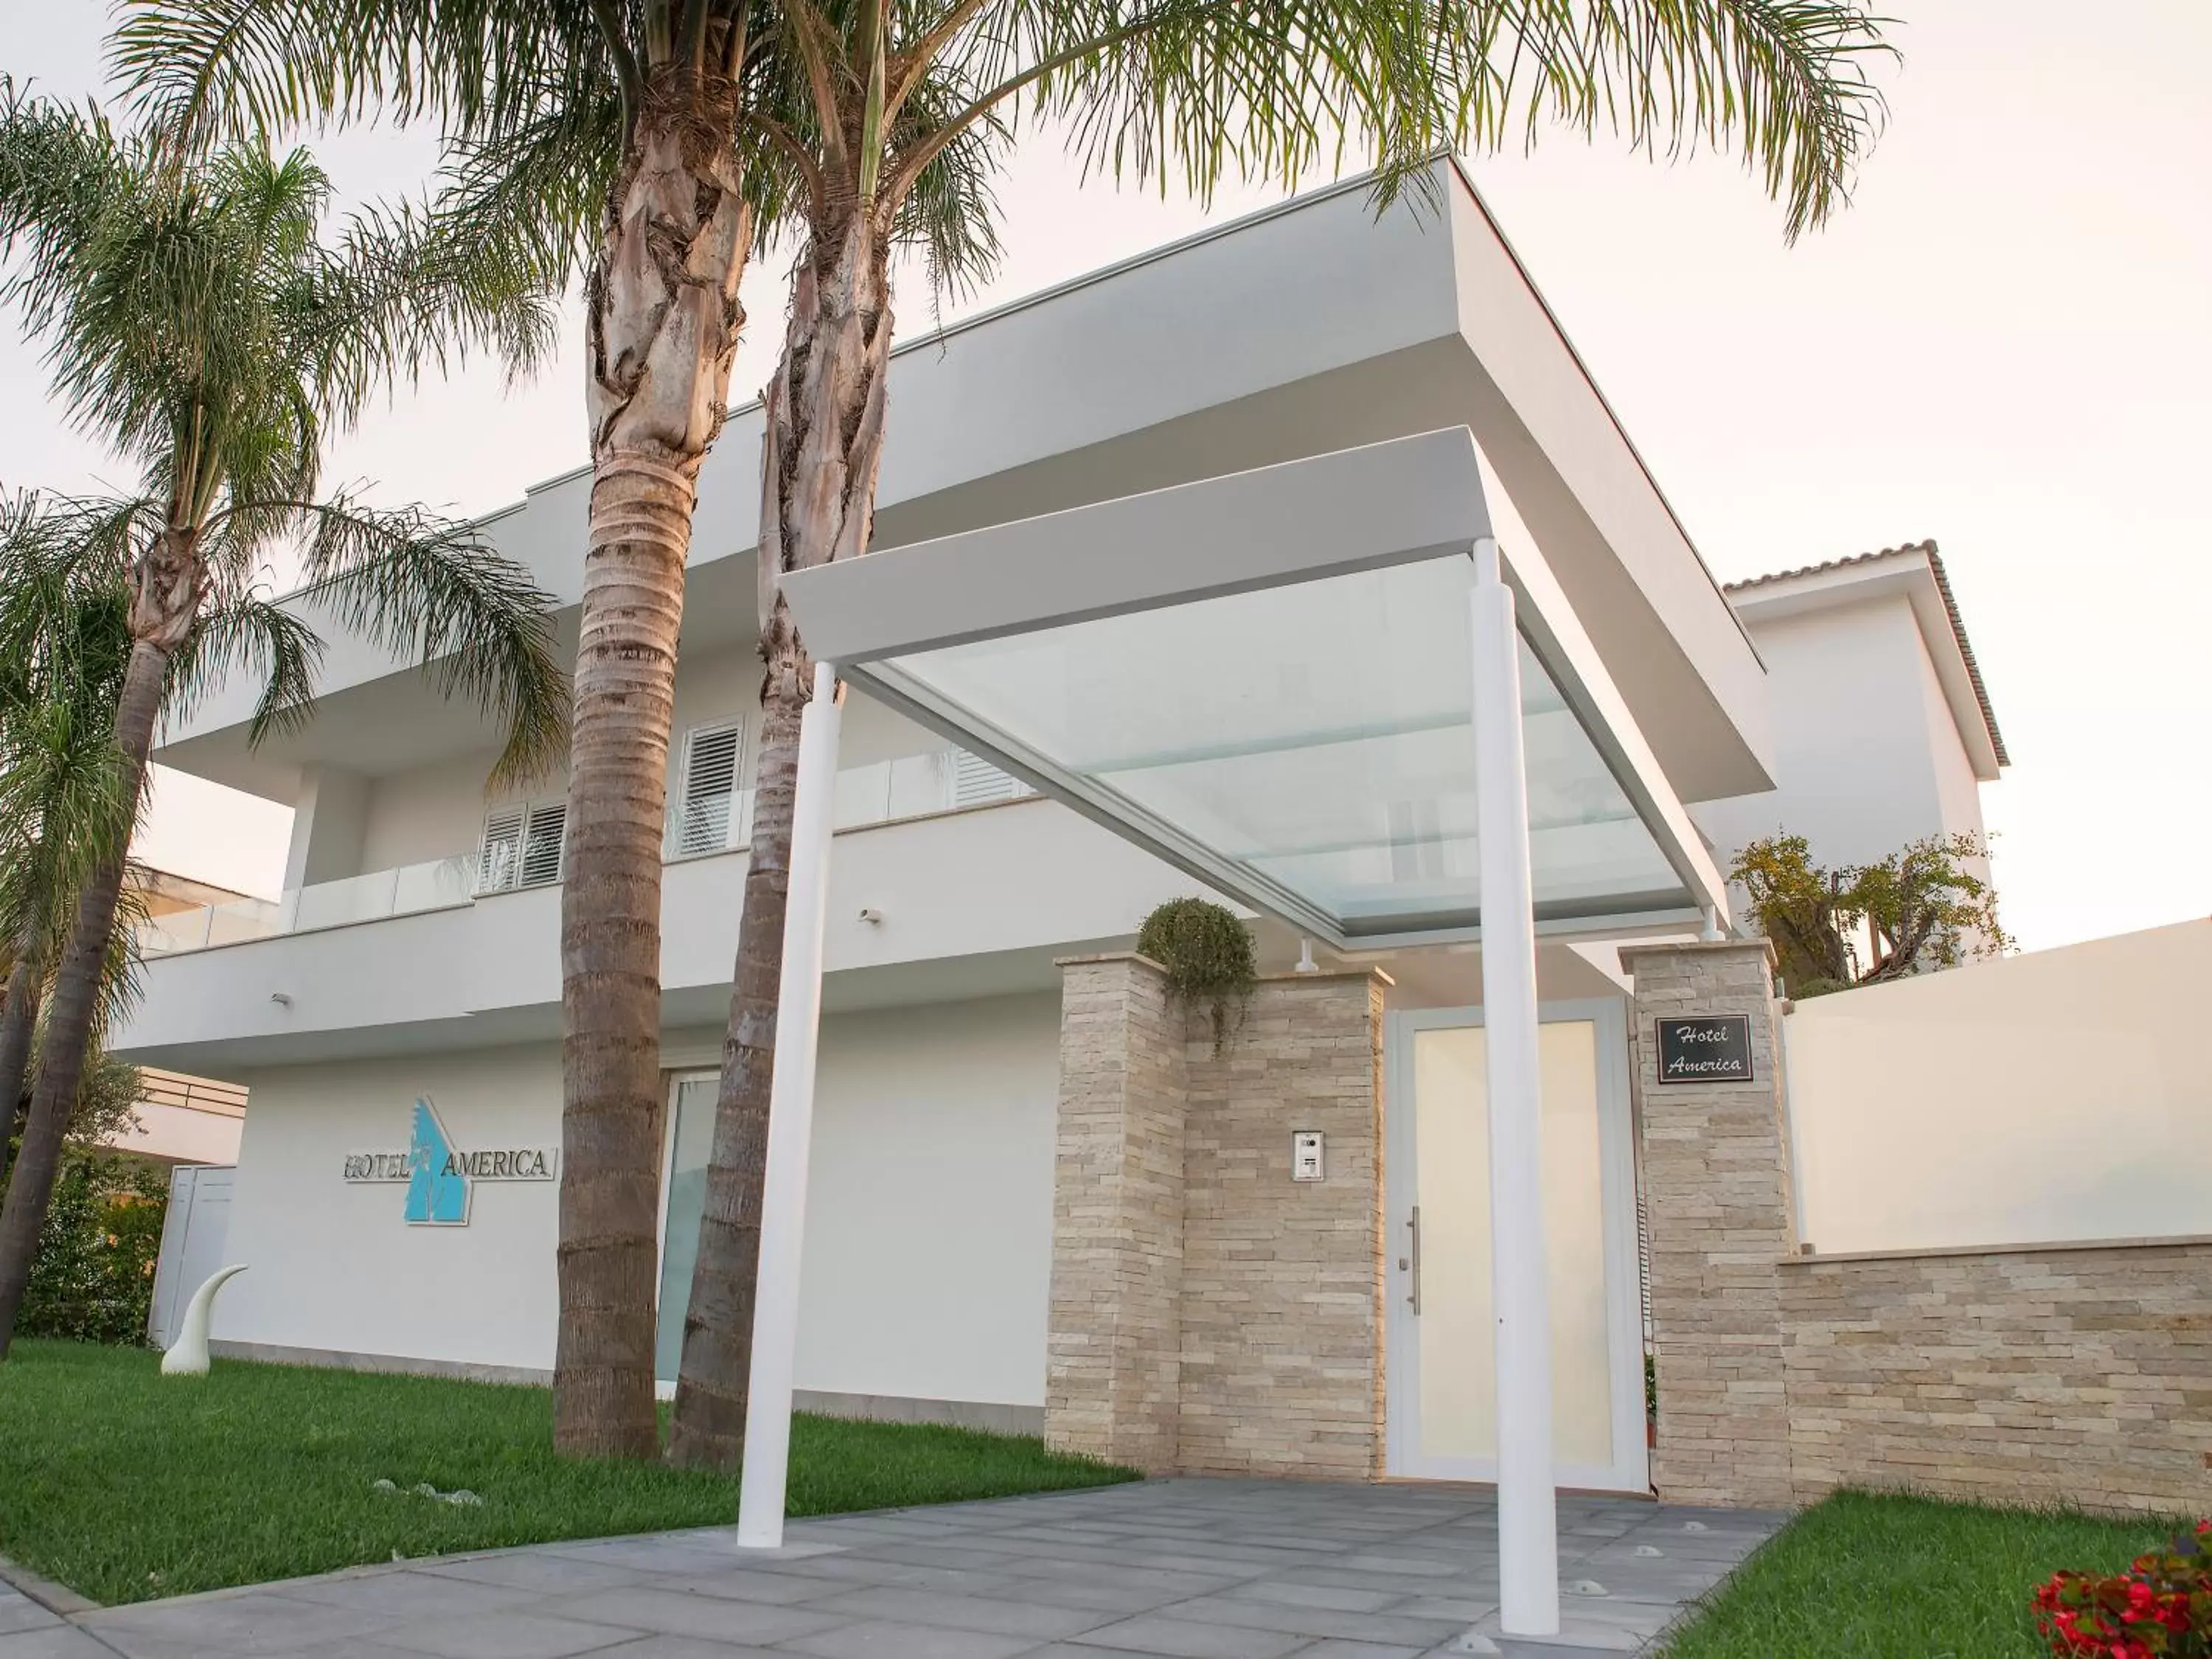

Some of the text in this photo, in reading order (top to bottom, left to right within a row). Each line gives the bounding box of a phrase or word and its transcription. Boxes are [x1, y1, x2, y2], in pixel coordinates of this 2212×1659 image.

[1676, 1026, 1729, 1043] Hotel
[1667, 1056, 1742, 1074] America
[344, 1150, 547, 1178] HOTEL AMERICA
